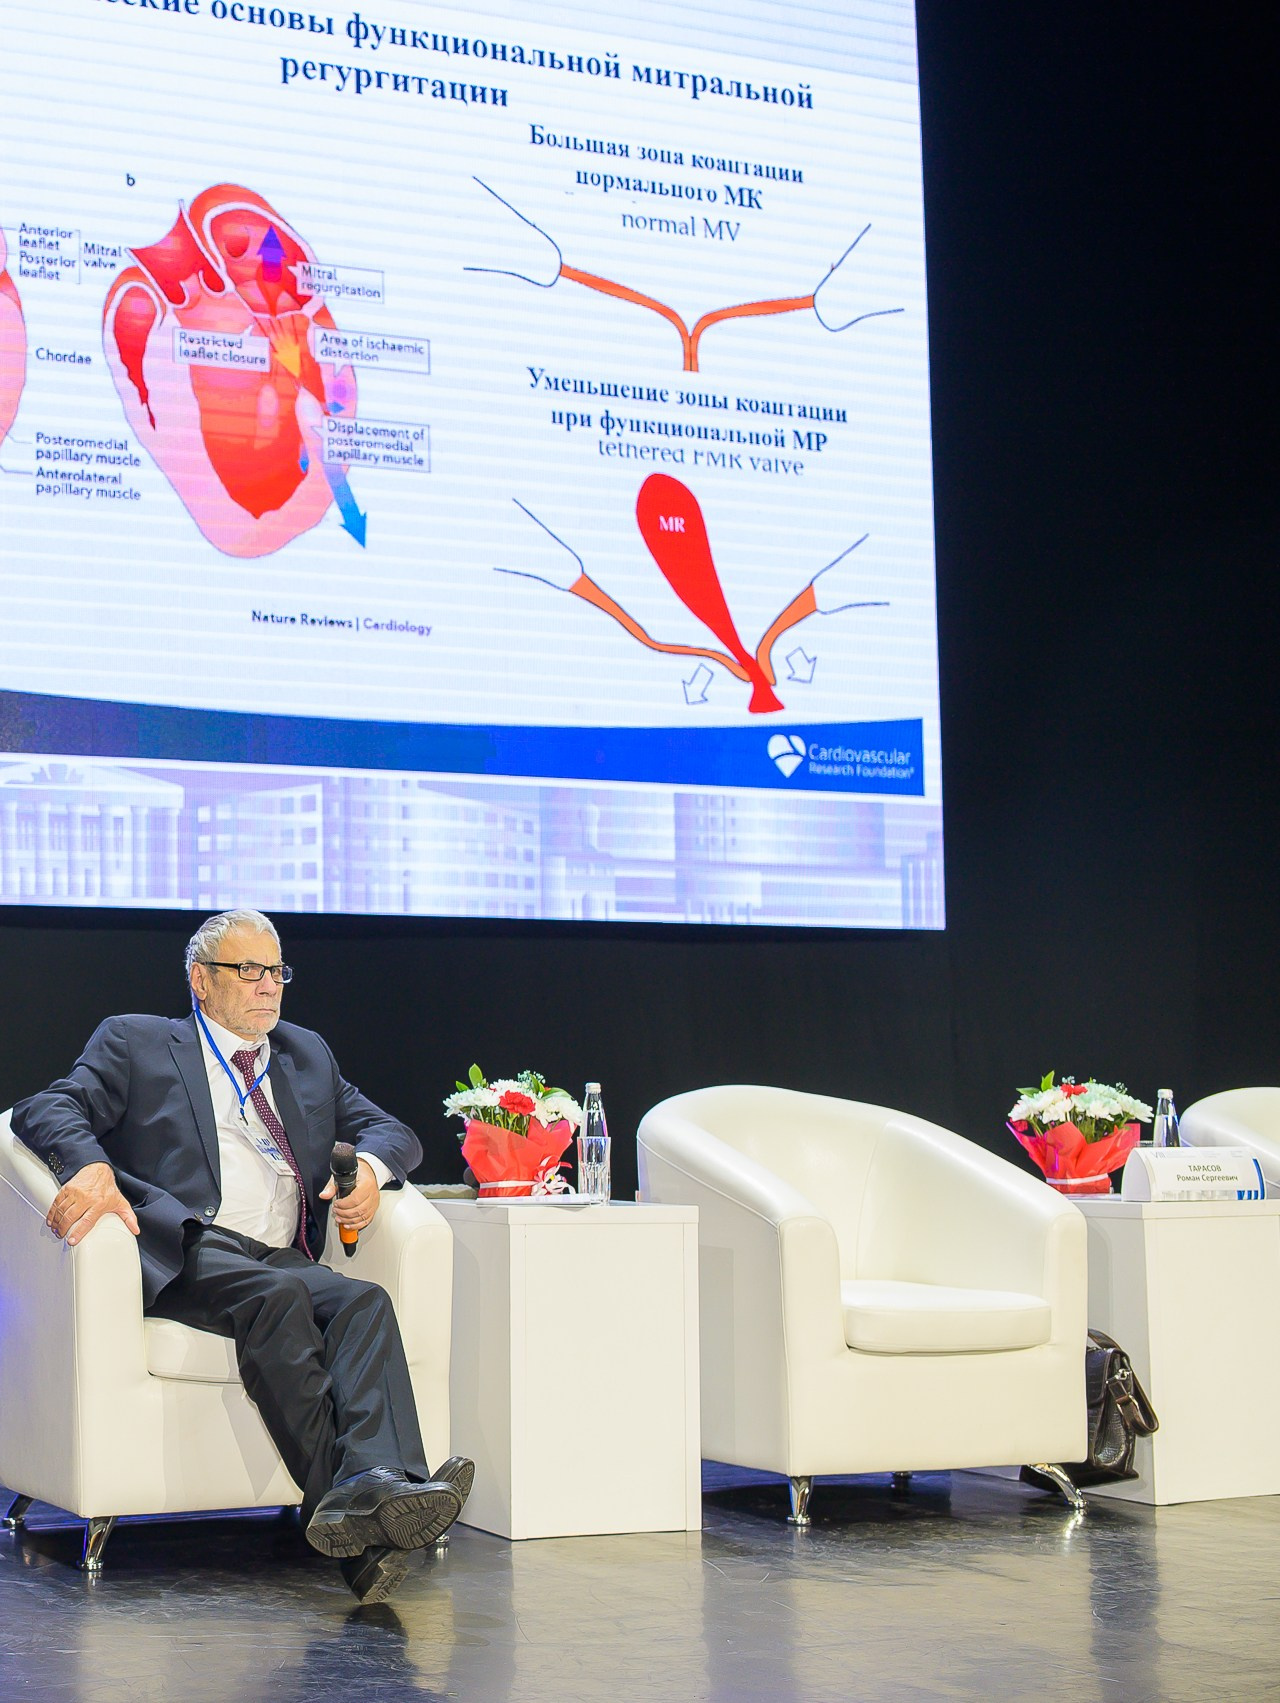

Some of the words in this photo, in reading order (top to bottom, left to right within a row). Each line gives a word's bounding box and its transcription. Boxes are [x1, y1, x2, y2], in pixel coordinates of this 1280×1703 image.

[211, 0, 335, 36] основы
[346, 13, 621, 80] функциональной
[632, 63, 815, 110] митральной
[280, 56, 509, 108] регургитации
[529, 123, 630, 158] Большая
[126, 173, 136, 187] b
[18, 222, 74, 239] Anterior
[621, 212, 697, 237] normal
[703, 218, 742, 242] MV
[19, 235, 60, 251] leaflet
[83, 242, 122, 257] Mitral
[20, 250, 77, 268] Posterior
[83, 258, 117, 270] valve
[19, 265, 61, 281] leaflet
[301, 264, 338, 281] Mitral
[301, 279, 382, 299] regurgitation
[179, 331, 243, 349] Restricted
[320, 332, 349, 346] Area
[351, 333, 364, 349] of
[365, 338, 425, 355] ischaemic
[35, 347, 93, 366] Chordae
[179, 346, 219, 361] leaflet
[222, 347, 267, 365] closure
[320, 346, 380, 363] distortion
[327, 418, 411, 440] Displacement
[413, 428, 426, 441] of
[36, 431, 129, 451] Posteromedial
[327, 436, 414, 454] posteromedial
[35, 448, 93, 465] papillary
[95, 453, 142, 467] muscle
[327, 448, 380, 466] papillary
[382, 451, 425, 467] muscle
[35, 466, 123, 485] Anterolateral
[35, 482, 93, 500] papillary
[95, 487, 142, 501] muscle
[659, 515, 687, 534] MR
[251, 609, 297, 625] Nature
[300, 613, 354, 629] Reviews
[363, 617, 432, 637] Cardiology
[808, 743, 911, 765] Cardiovascular
[1188, 1164, 1222, 1172] ТАРАСОВ
[1201, 1174, 1239, 1182] Сергеевич
